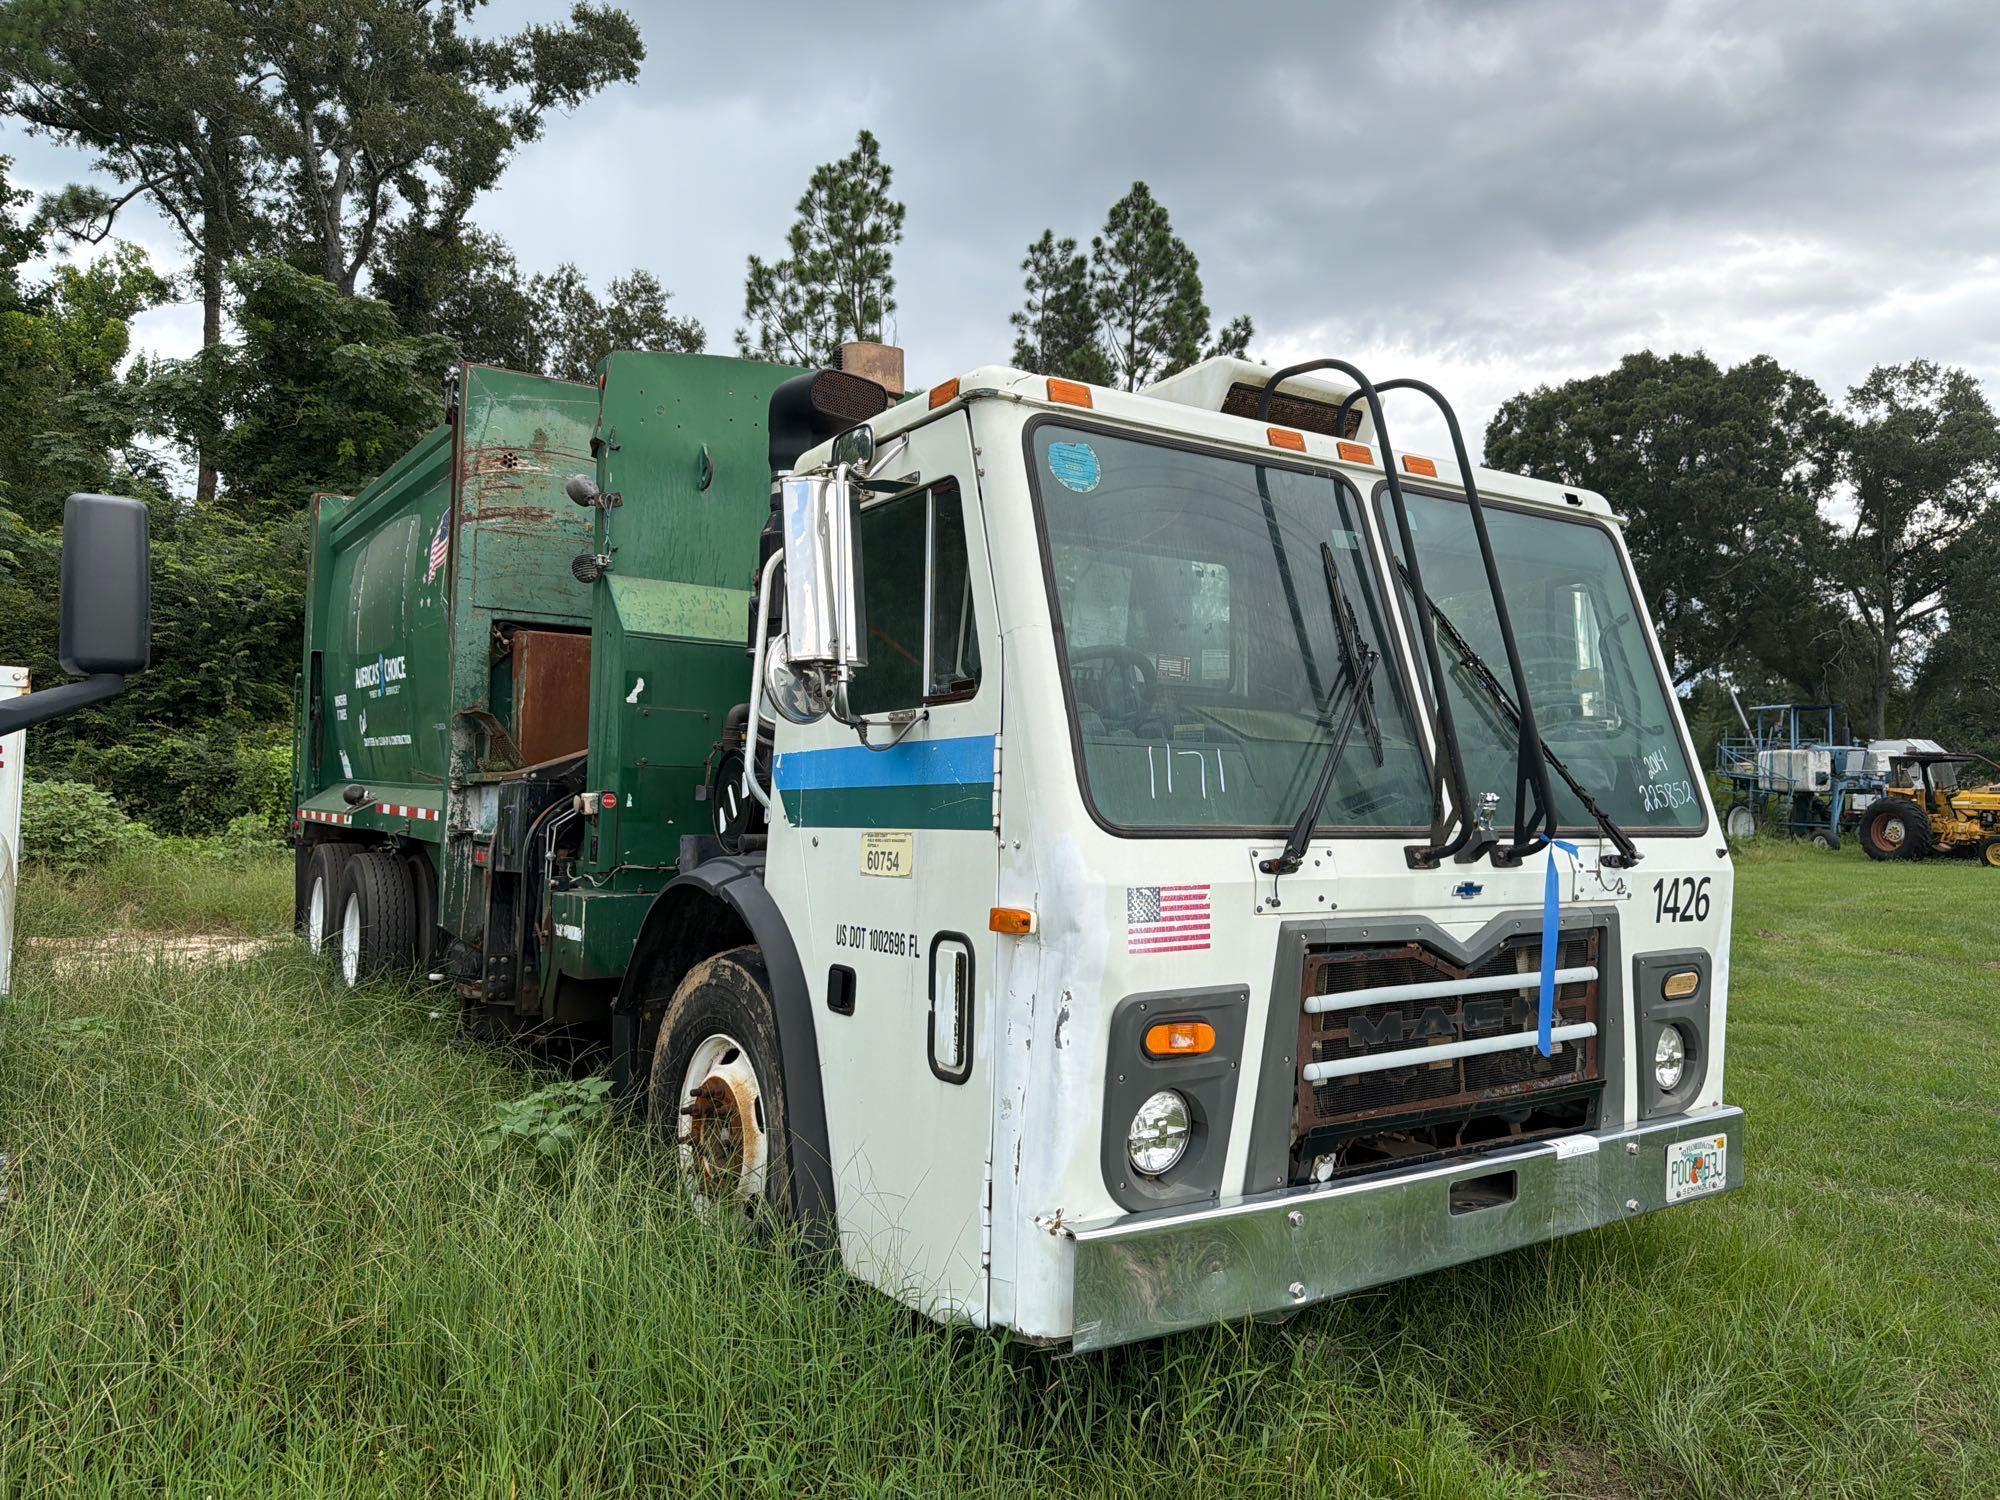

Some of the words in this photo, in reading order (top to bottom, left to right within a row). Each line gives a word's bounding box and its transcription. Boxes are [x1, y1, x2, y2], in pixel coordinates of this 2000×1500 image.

[384, 656, 407, 682] CHOICE
[1638, 780, 1697, 813] 225852
[867, 850, 899, 872] 60754
[1652, 876, 1711, 924] 1426
[836, 923, 847, 946] US
[849, 925, 866, 949] DOT
[869, 928, 906, 956] 1002696
[908, 934, 920, 958] FL
